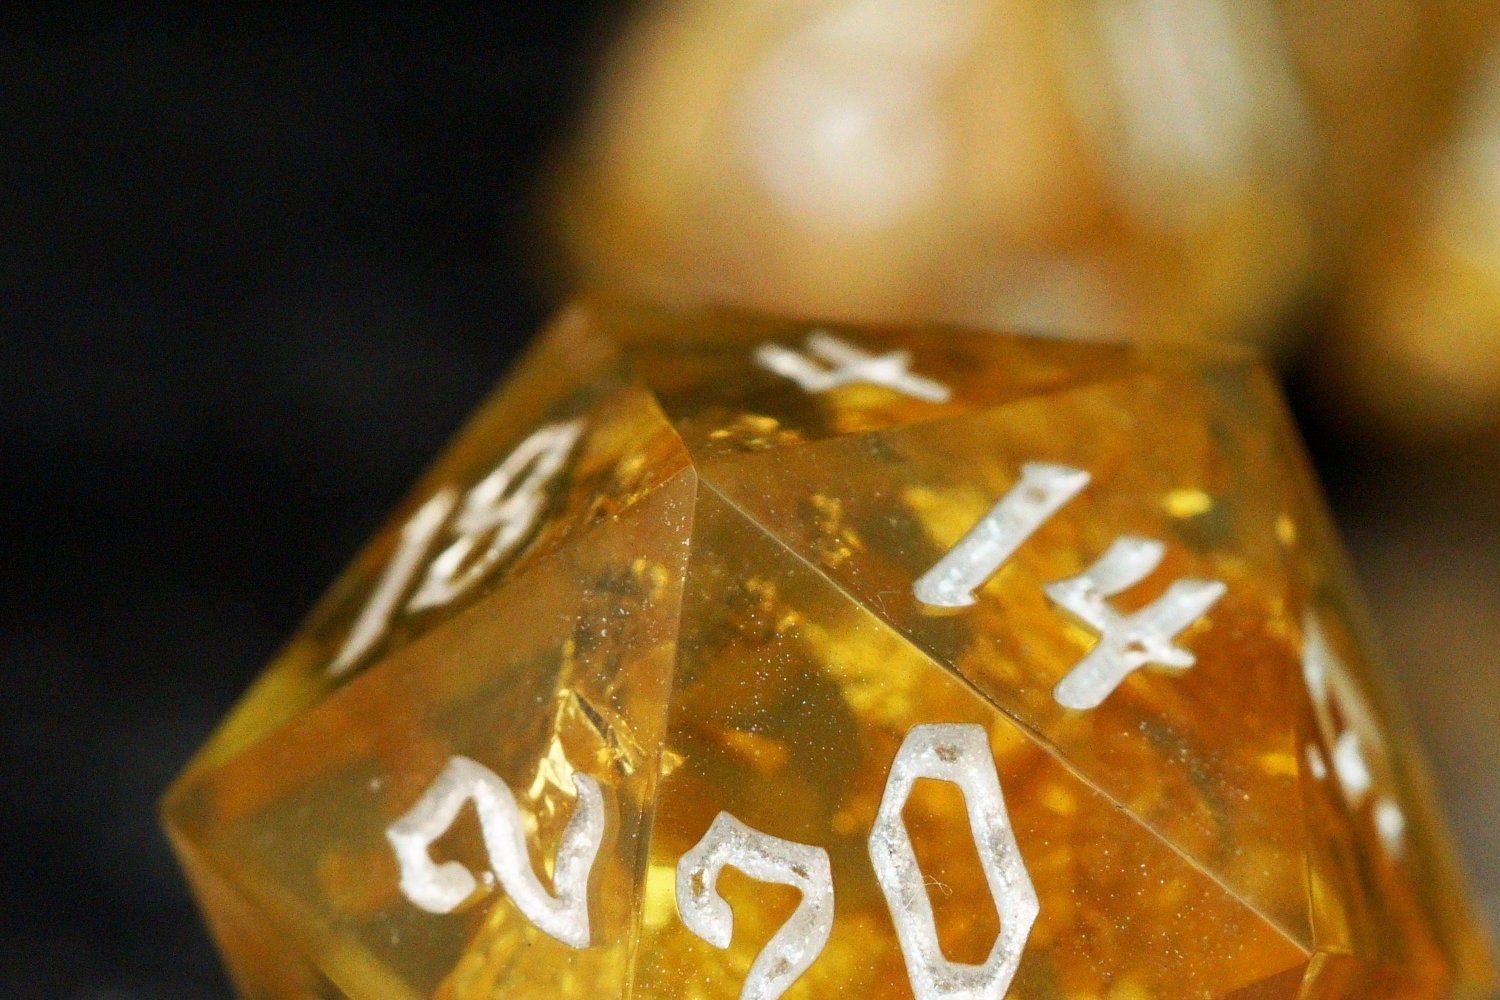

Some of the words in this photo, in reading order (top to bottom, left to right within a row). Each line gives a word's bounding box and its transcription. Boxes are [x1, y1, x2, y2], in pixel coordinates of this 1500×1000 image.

[753, 330, 952, 401] 4
[912, 461, 1228, 711] 14
[386, 754, 606, 950] 2
